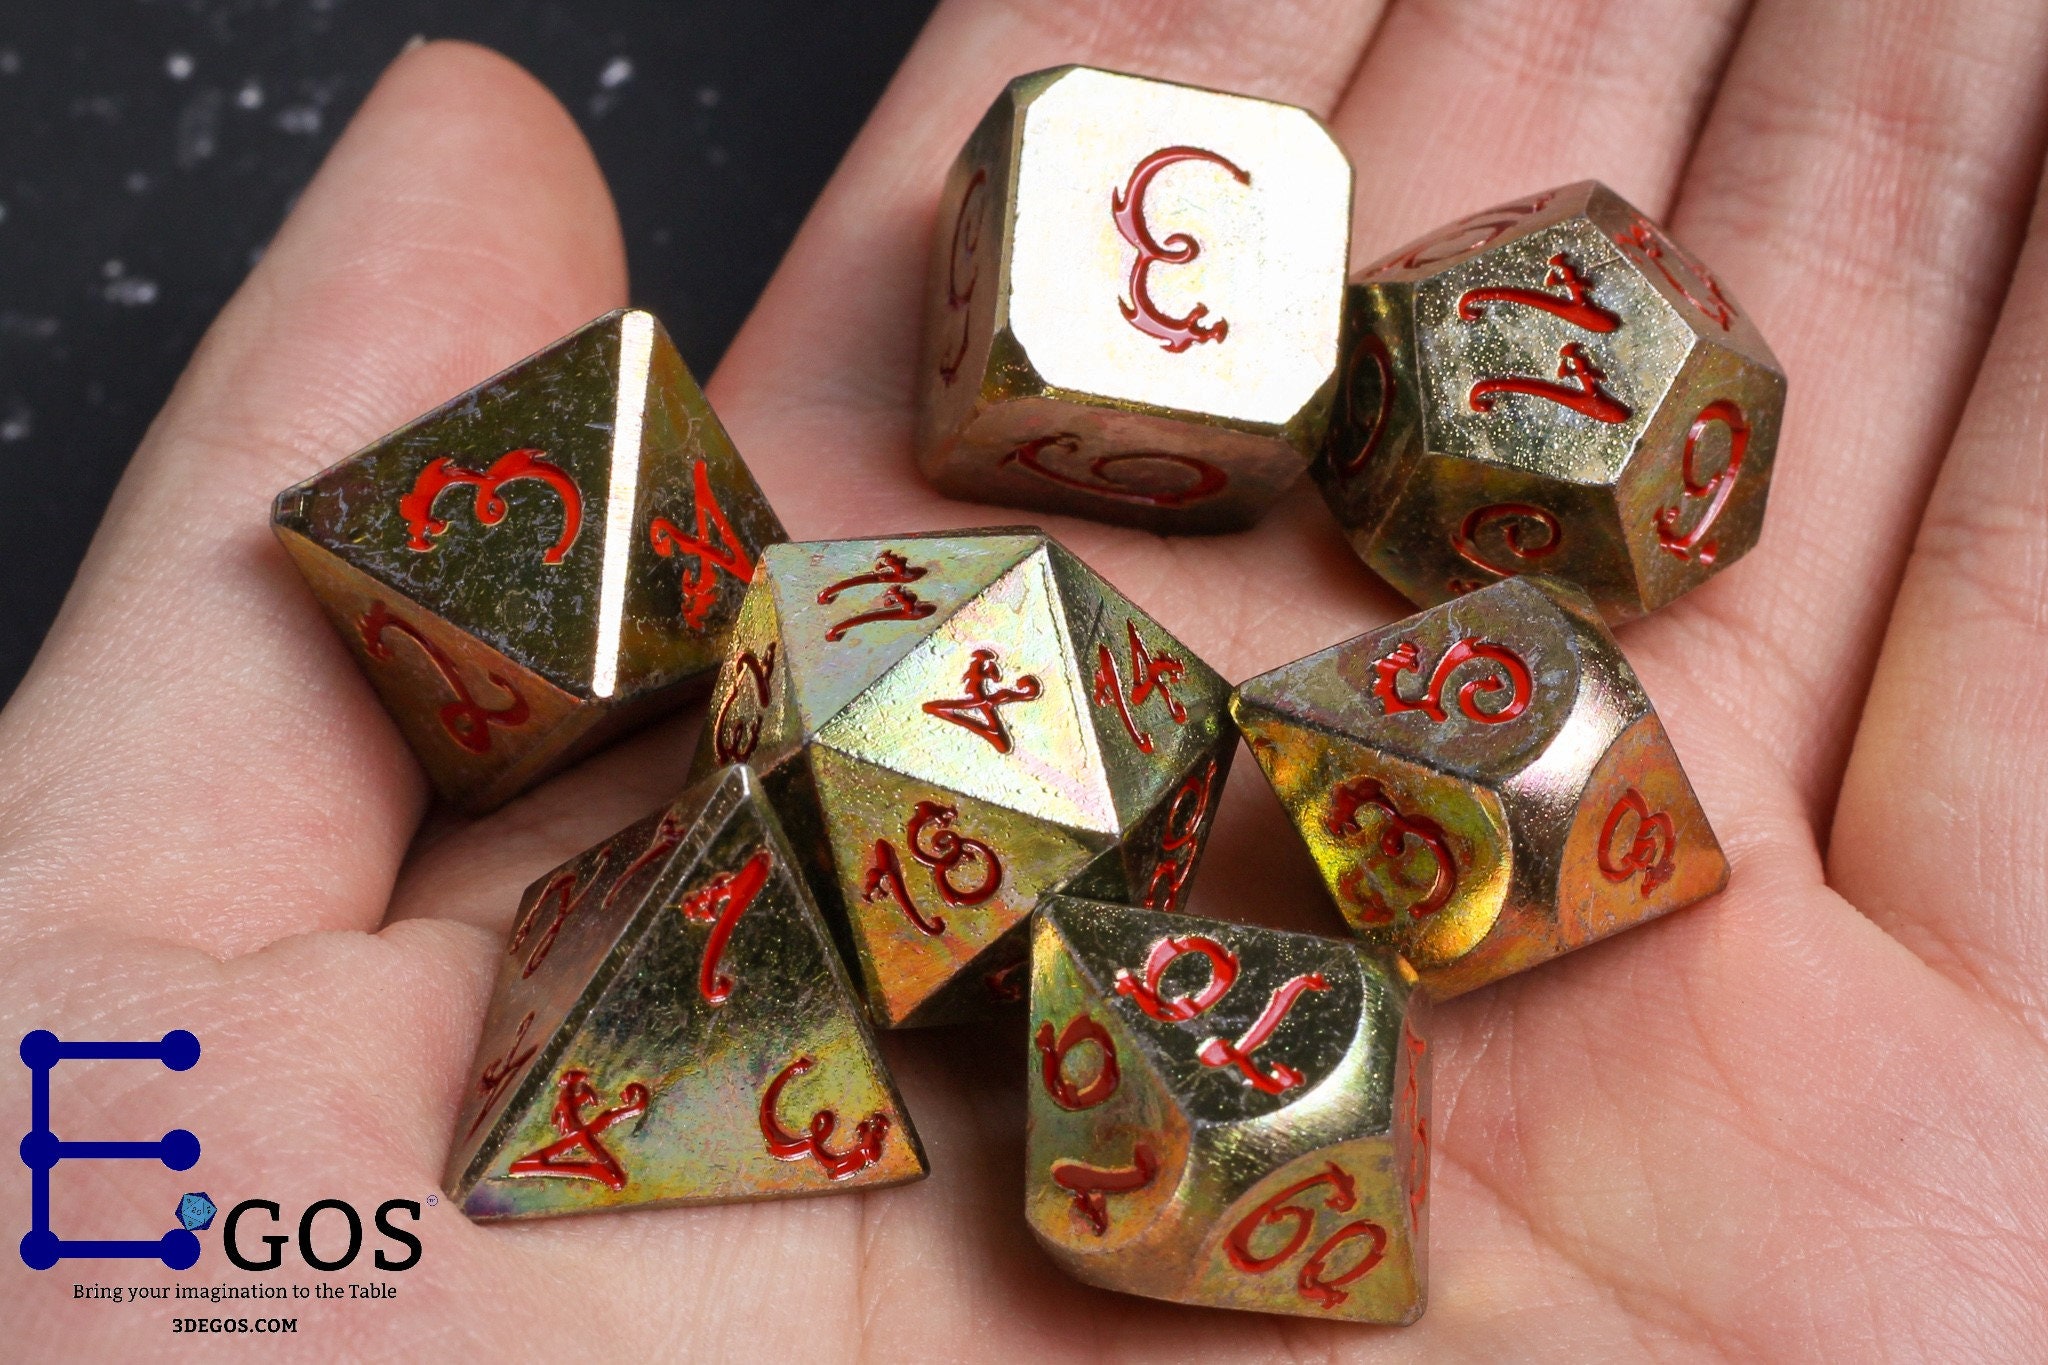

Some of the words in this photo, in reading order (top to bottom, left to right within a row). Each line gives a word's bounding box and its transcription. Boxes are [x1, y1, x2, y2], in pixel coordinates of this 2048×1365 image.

[1112, 145, 1251, 353] 3
[400, 448, 583, 564] 3
[922, 649, 1044, 755] 4
[1095, 618, 1187, 754] 14
[863, 800, 1003, 937] 18
[509, 1070, 649, 1192] 4
[760, 1056, 890, 1180] 3
[1223, 1161, 1387, 1310] 60
